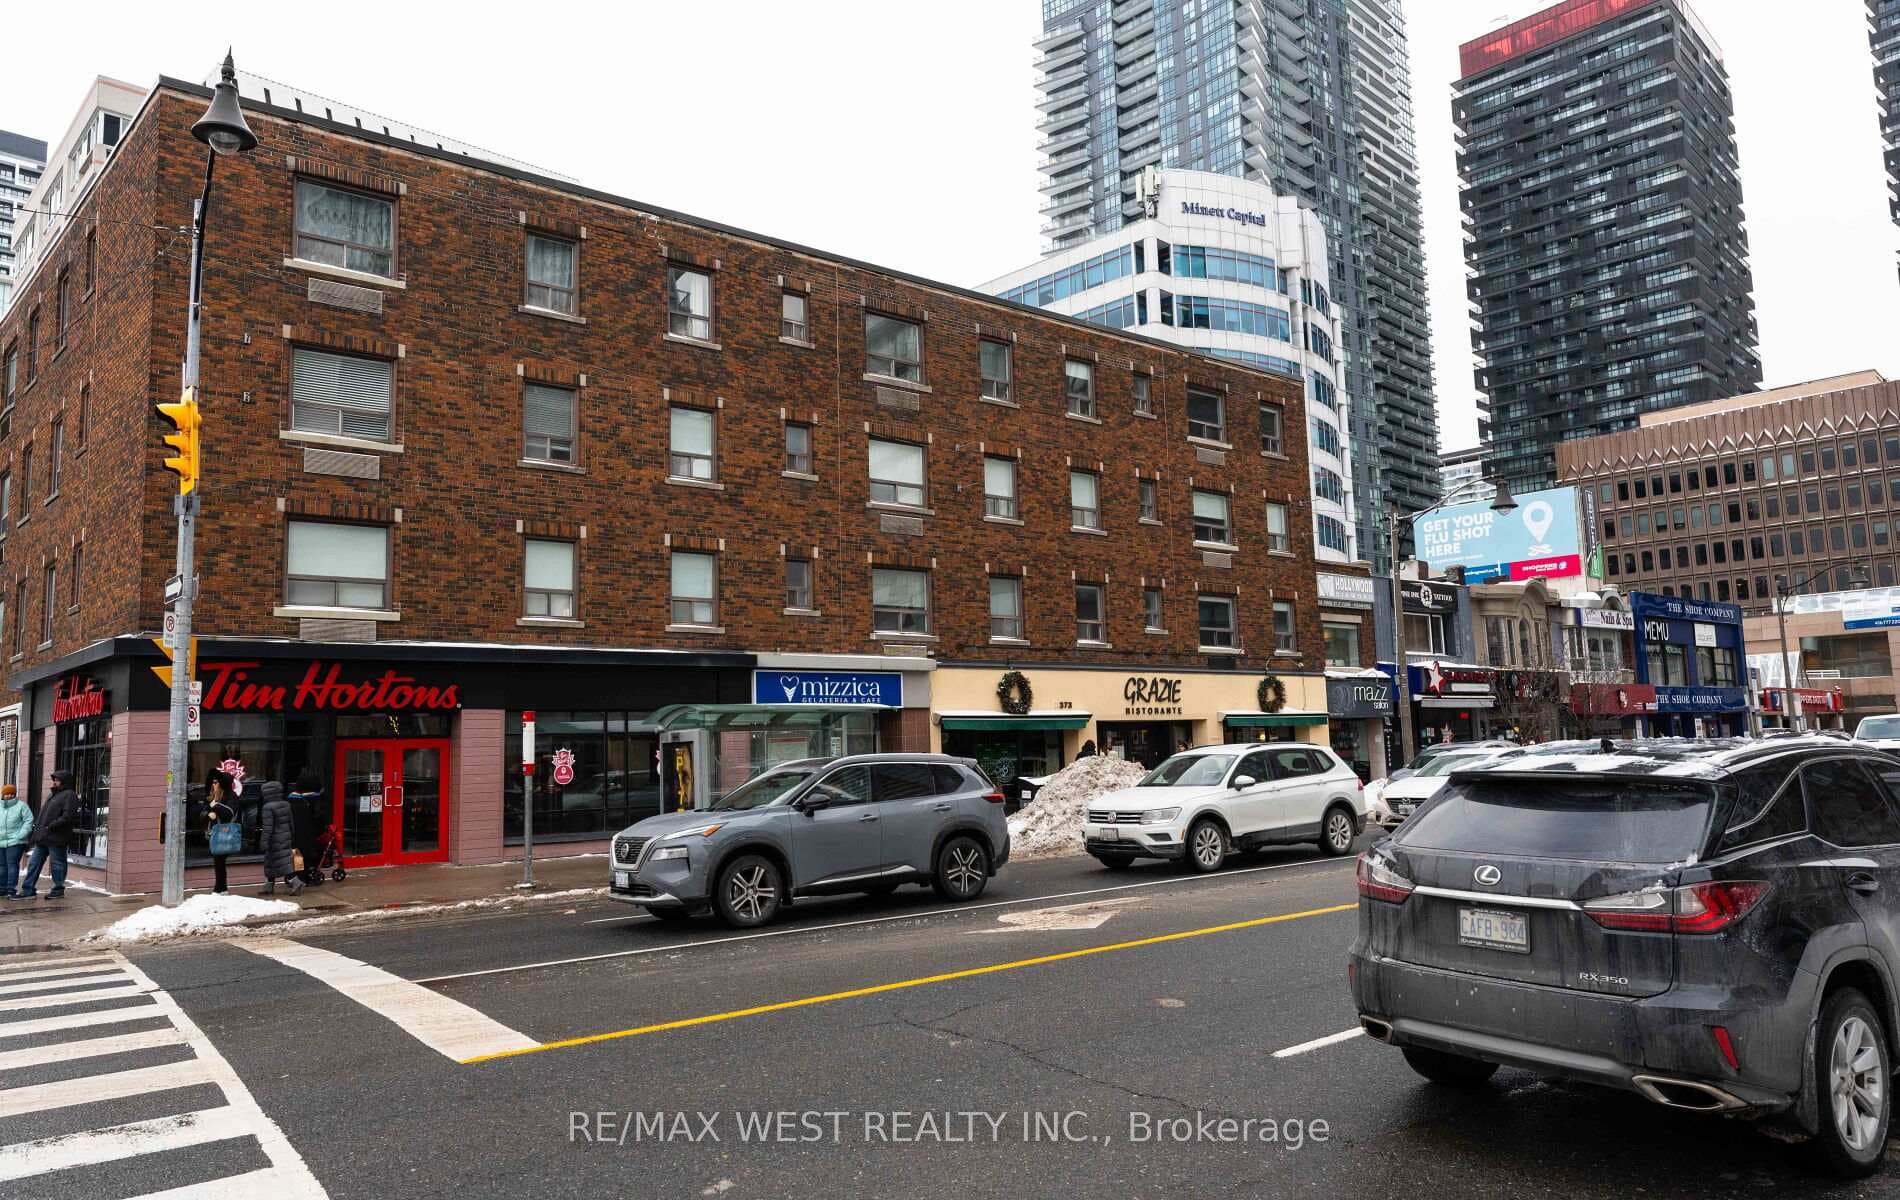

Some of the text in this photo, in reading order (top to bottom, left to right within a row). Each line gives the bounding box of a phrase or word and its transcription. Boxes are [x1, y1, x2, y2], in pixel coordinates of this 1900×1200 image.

[1181, 201, 1266, 227] Minett Capital
[1424, 511, 1494, 533] GET YOUR
[1424, 524, 1492, 545] FLU SHOT
[1425, 542, 1461, 558] HERE
[1335, 577, 1373, 593] HOLLYWOOD
[1600, 611, 1615, 625] Nails
[1616, 612, 1622, 625] &
[1622, 614, 1633, 628] Spa
[1667, 602, 1734, 620] THE SHOE COMPANY
[1644, 620, 1669, 641] MEMU
[200, 661, 458, 710] Tim Hortons
[802, 677, 881, 697] mizzica
[1124, 677, 1182, 705] GRAZIE
[1354, 684, 1388, 702] mazz
[1373, 701, 1389, 710] salon
[1656, 694, 1723, 704] THE SHOE COMPANY
[1125, 707, 1182, 715] RISTORANTE
